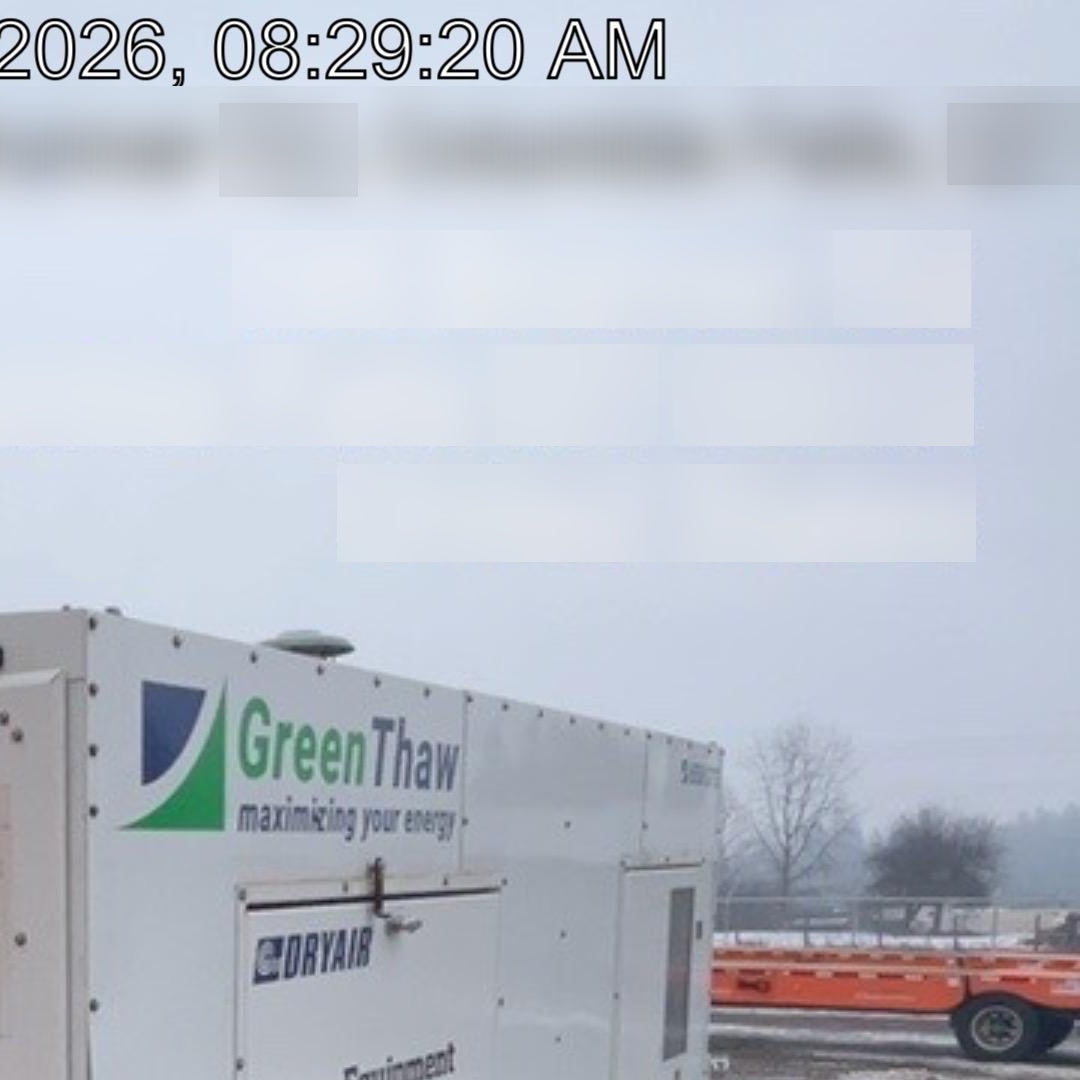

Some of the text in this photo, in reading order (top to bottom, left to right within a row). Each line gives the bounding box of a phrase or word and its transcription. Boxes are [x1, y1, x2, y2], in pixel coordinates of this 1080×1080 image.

[237, 796, 456, 842] maximizing your energy
[283, 926, 373, 980] DRYAIR
